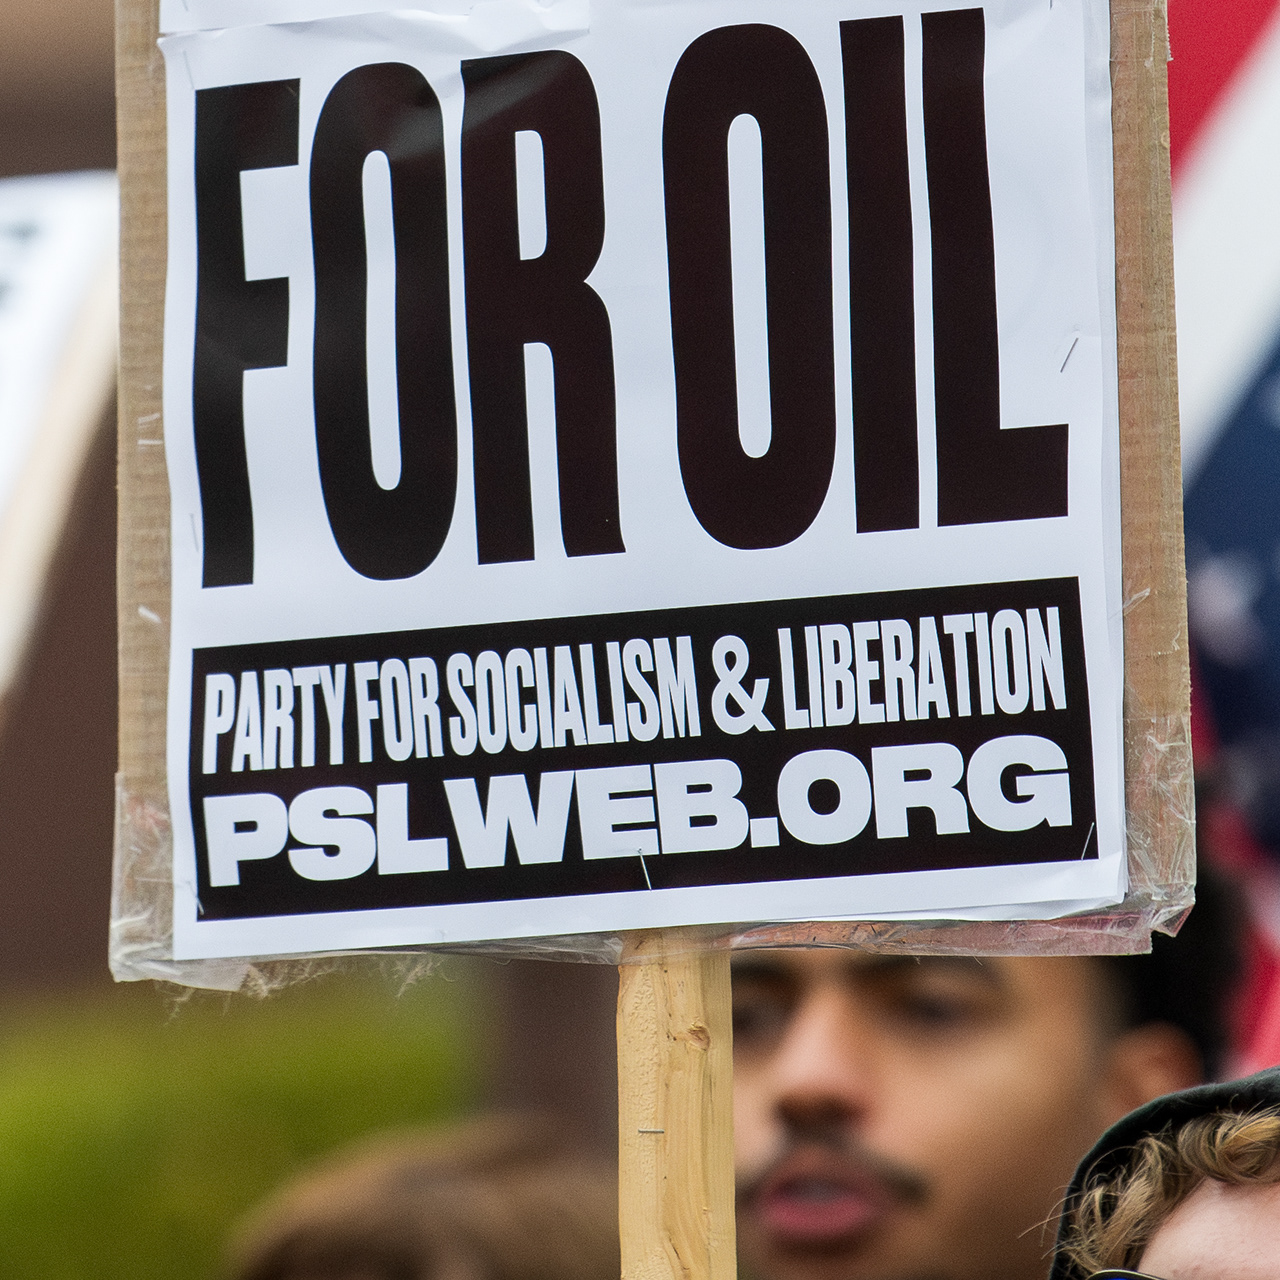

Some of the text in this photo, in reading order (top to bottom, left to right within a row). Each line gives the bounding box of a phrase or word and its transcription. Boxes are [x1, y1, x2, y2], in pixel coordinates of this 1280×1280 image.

[191, 48, 627, 590] FOR
[660, 6, 1070, 552] OIL
[201, 605, 1068, 776] PARTY FOR SOCIALISM & LIBERATION
[201, 733, 1074, 890] PSLWEB.ORG
